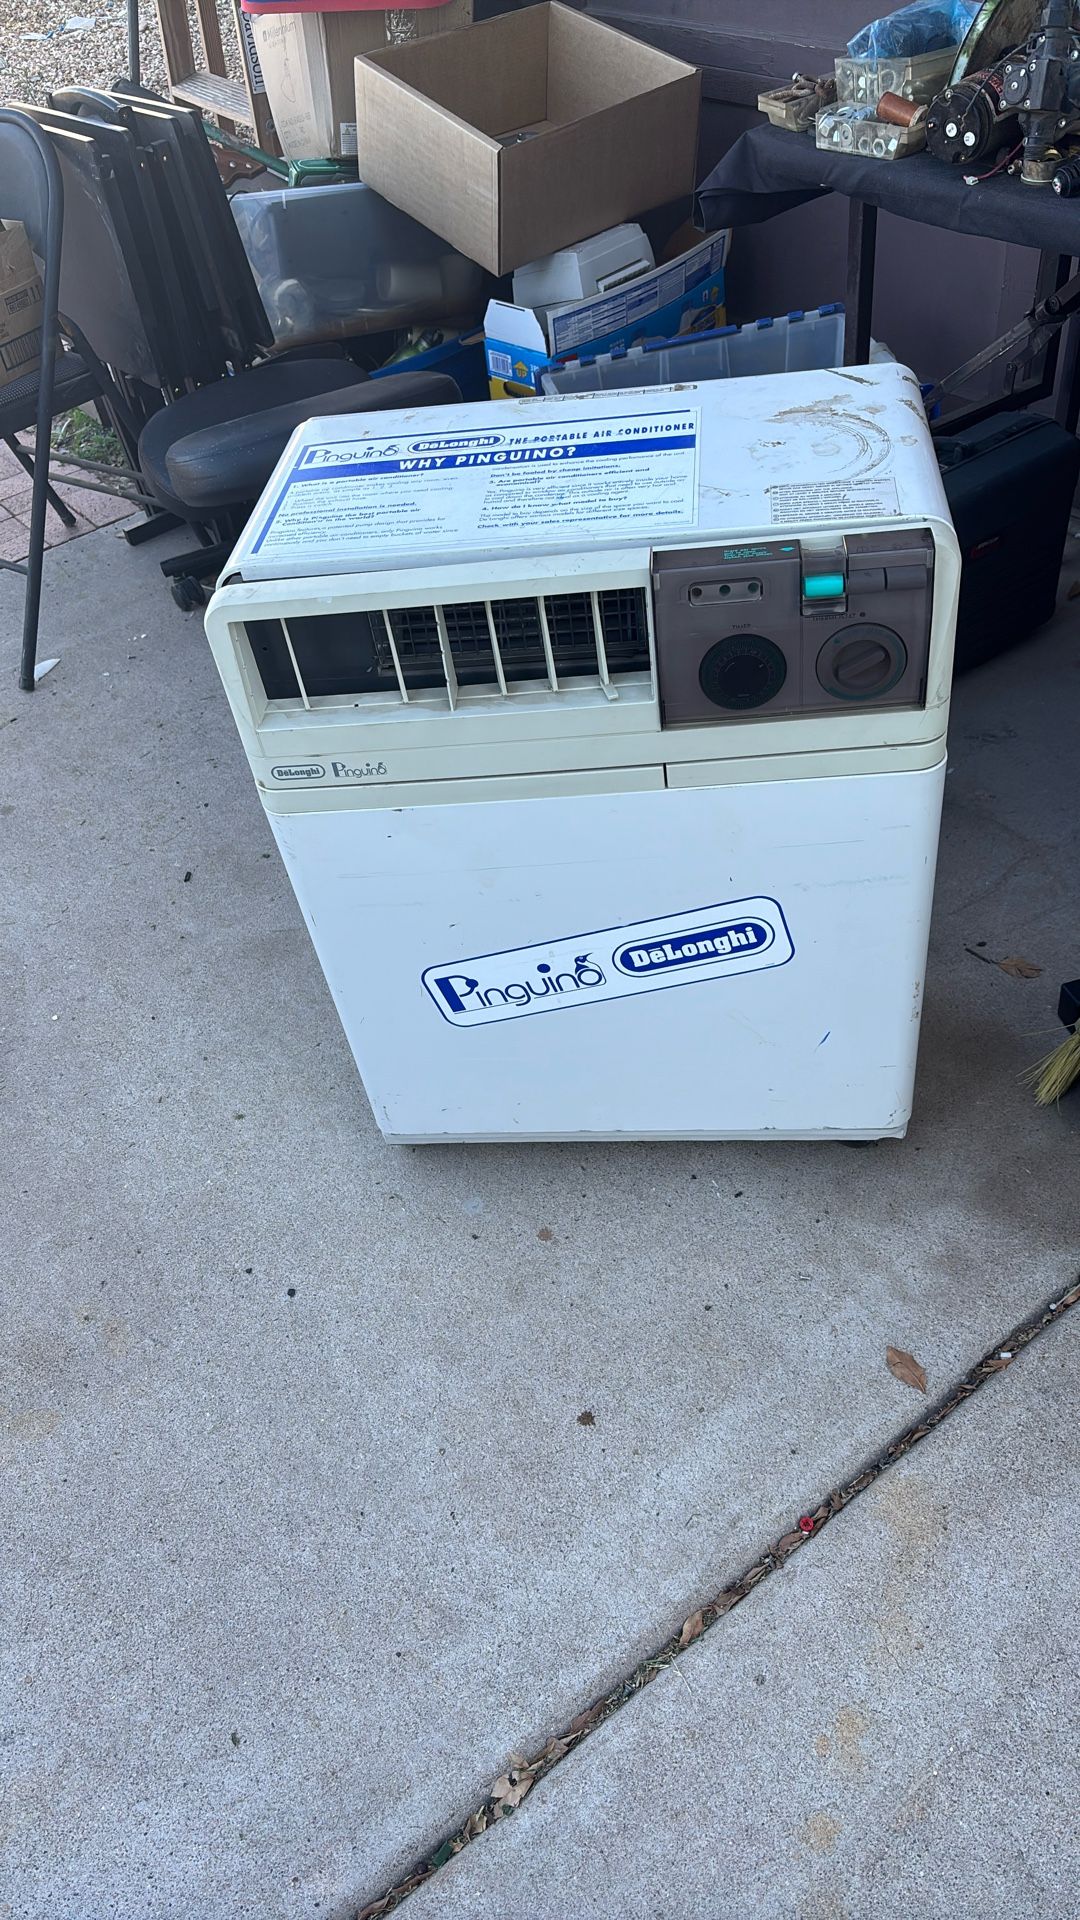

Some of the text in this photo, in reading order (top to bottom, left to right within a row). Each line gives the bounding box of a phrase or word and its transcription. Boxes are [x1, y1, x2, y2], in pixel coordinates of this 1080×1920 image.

[509, 437, 529, 446] THE
[534, 432, 587, 443] PORTABLE
[593, 430, 612, 438] AIR
[617, 422, 694, 436] CONDITIONER
[400, 446, 577, 470] WHY PINGUINO?
[434, 953, 606, 1014] Pinguino
